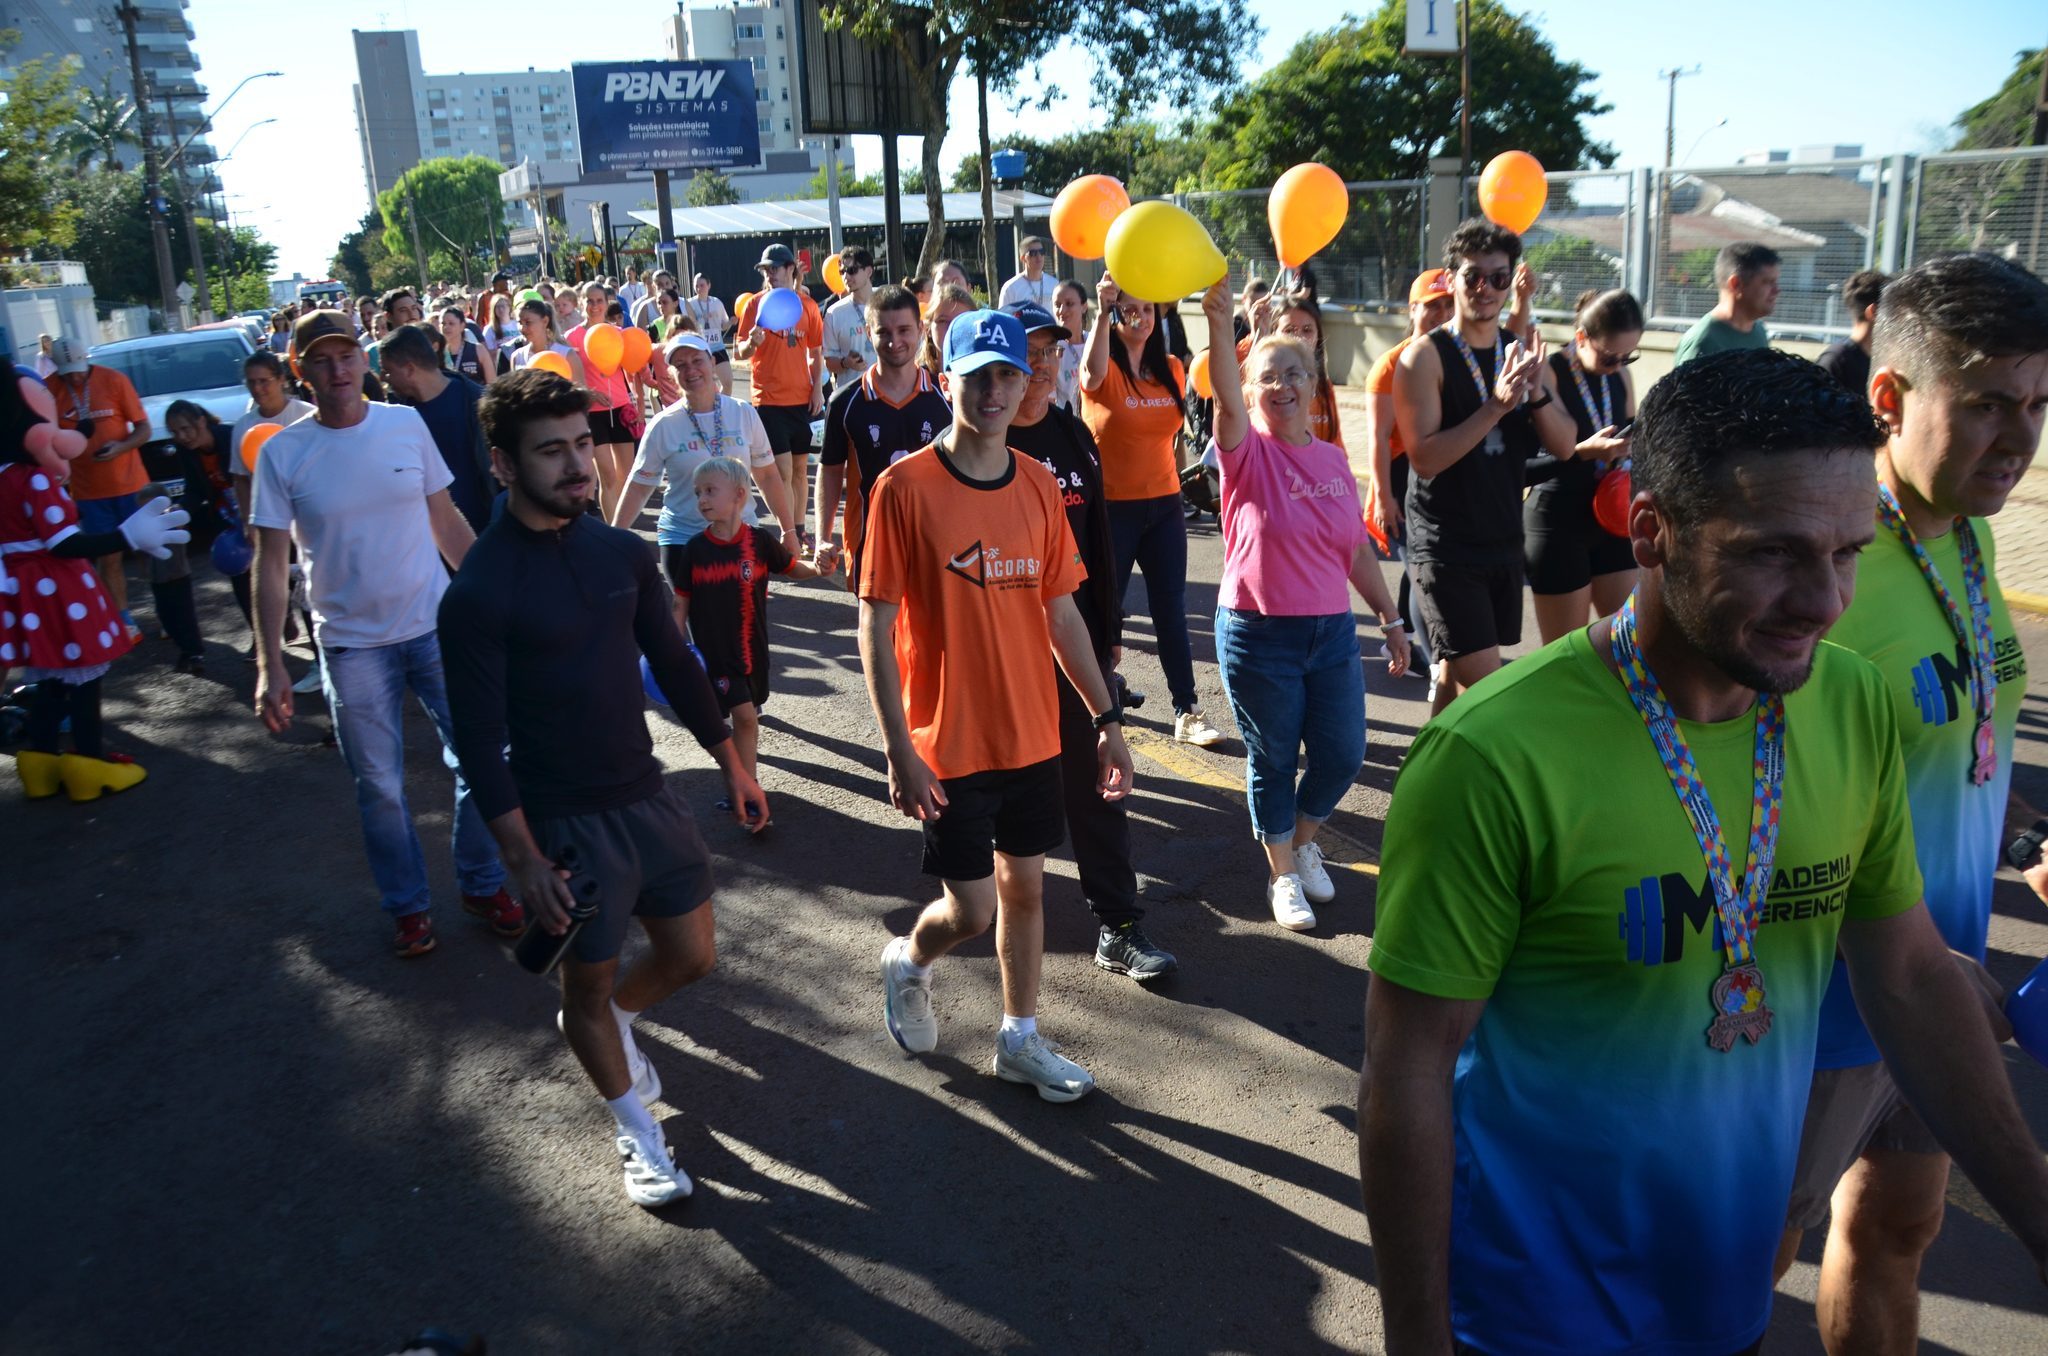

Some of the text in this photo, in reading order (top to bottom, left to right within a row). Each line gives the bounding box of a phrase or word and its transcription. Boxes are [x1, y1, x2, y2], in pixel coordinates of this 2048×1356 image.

[604, 69, 726, 103] PBNEW
[635, 100, 728, 115] SISTEMAS
[628, 121, 709, 132] Soluções tecnológicas
[642, 130, 674, 140] produtos
[974, 319, 1010, 348] LA
[1140, 396, 1176, 408] CRESO
[1056, 471, 1084, 489] o &
[1063, 489, 1085, 506] do.
